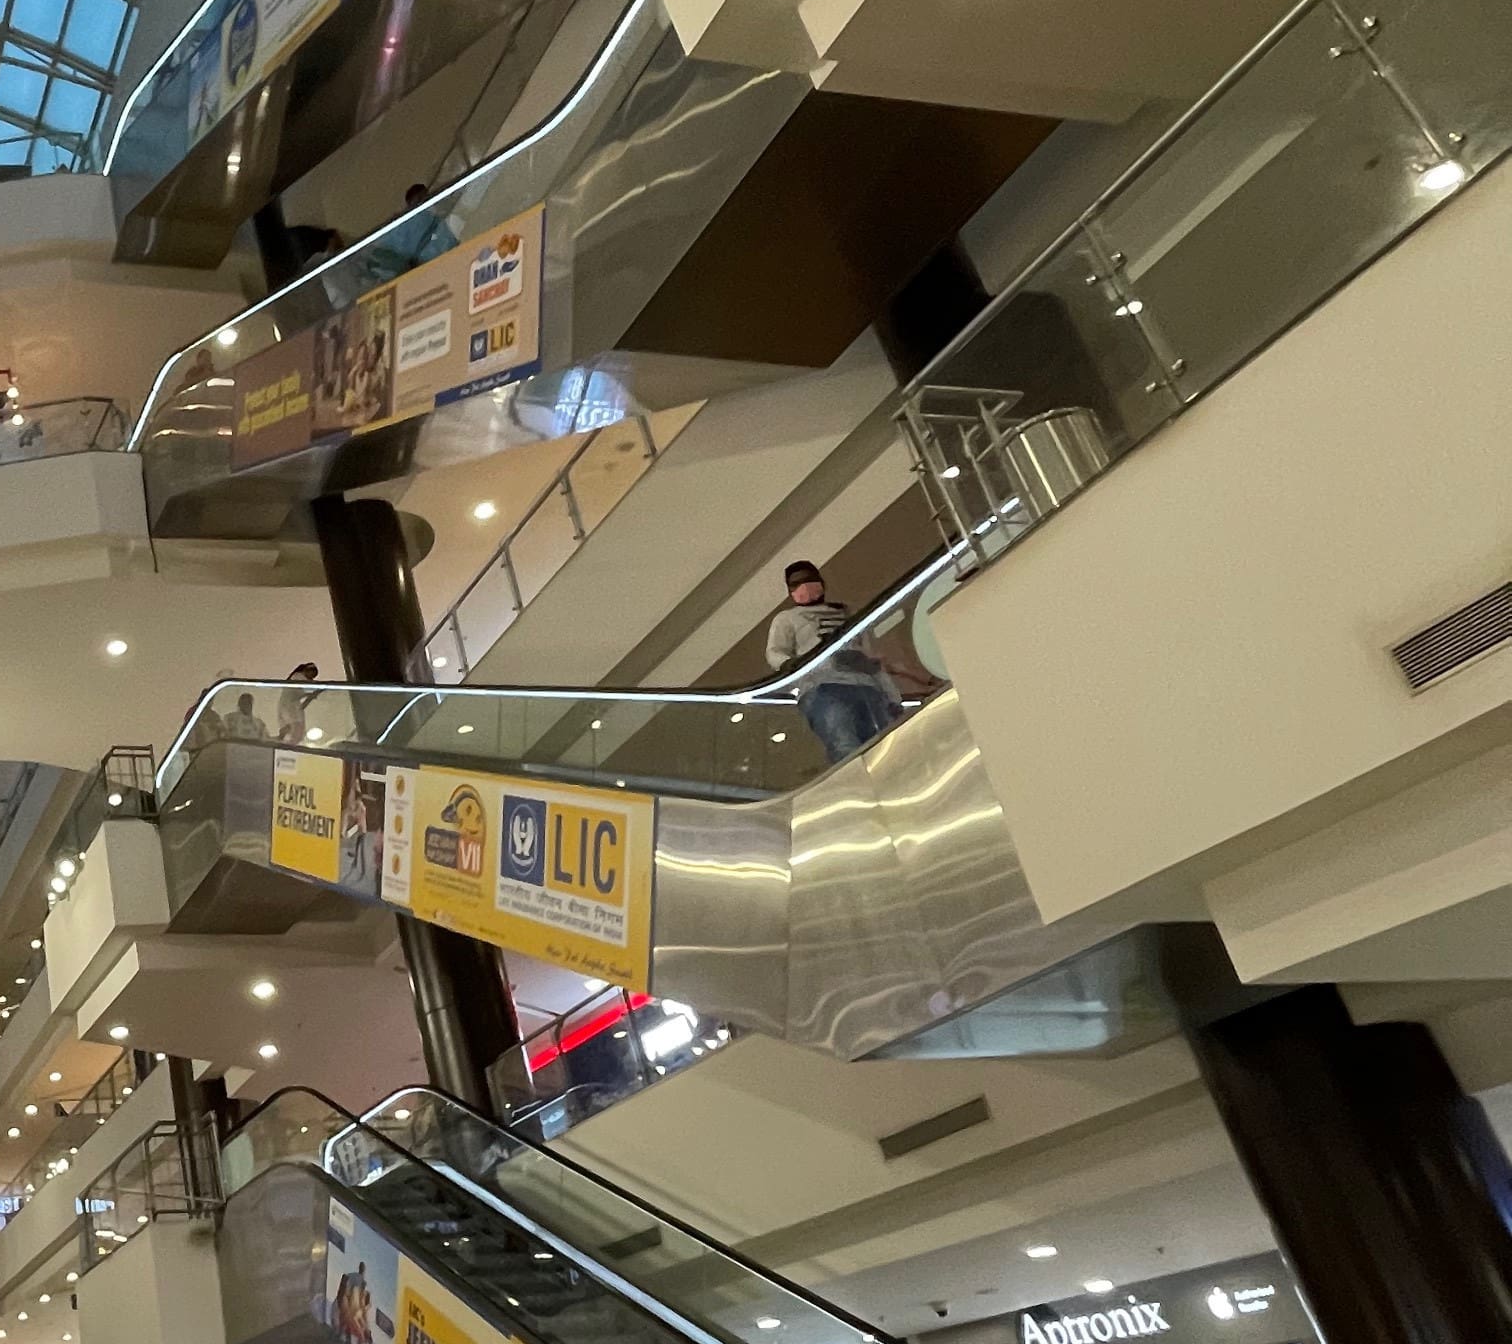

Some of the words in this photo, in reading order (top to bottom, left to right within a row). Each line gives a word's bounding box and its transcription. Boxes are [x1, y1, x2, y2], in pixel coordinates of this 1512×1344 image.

[489, 322, 515, 352] LIC
[277, 781, 317, 810] PLAYFUL
[277, 806, 336, 840] RETIREMENT
[553, 813, 617, 895] LIC
